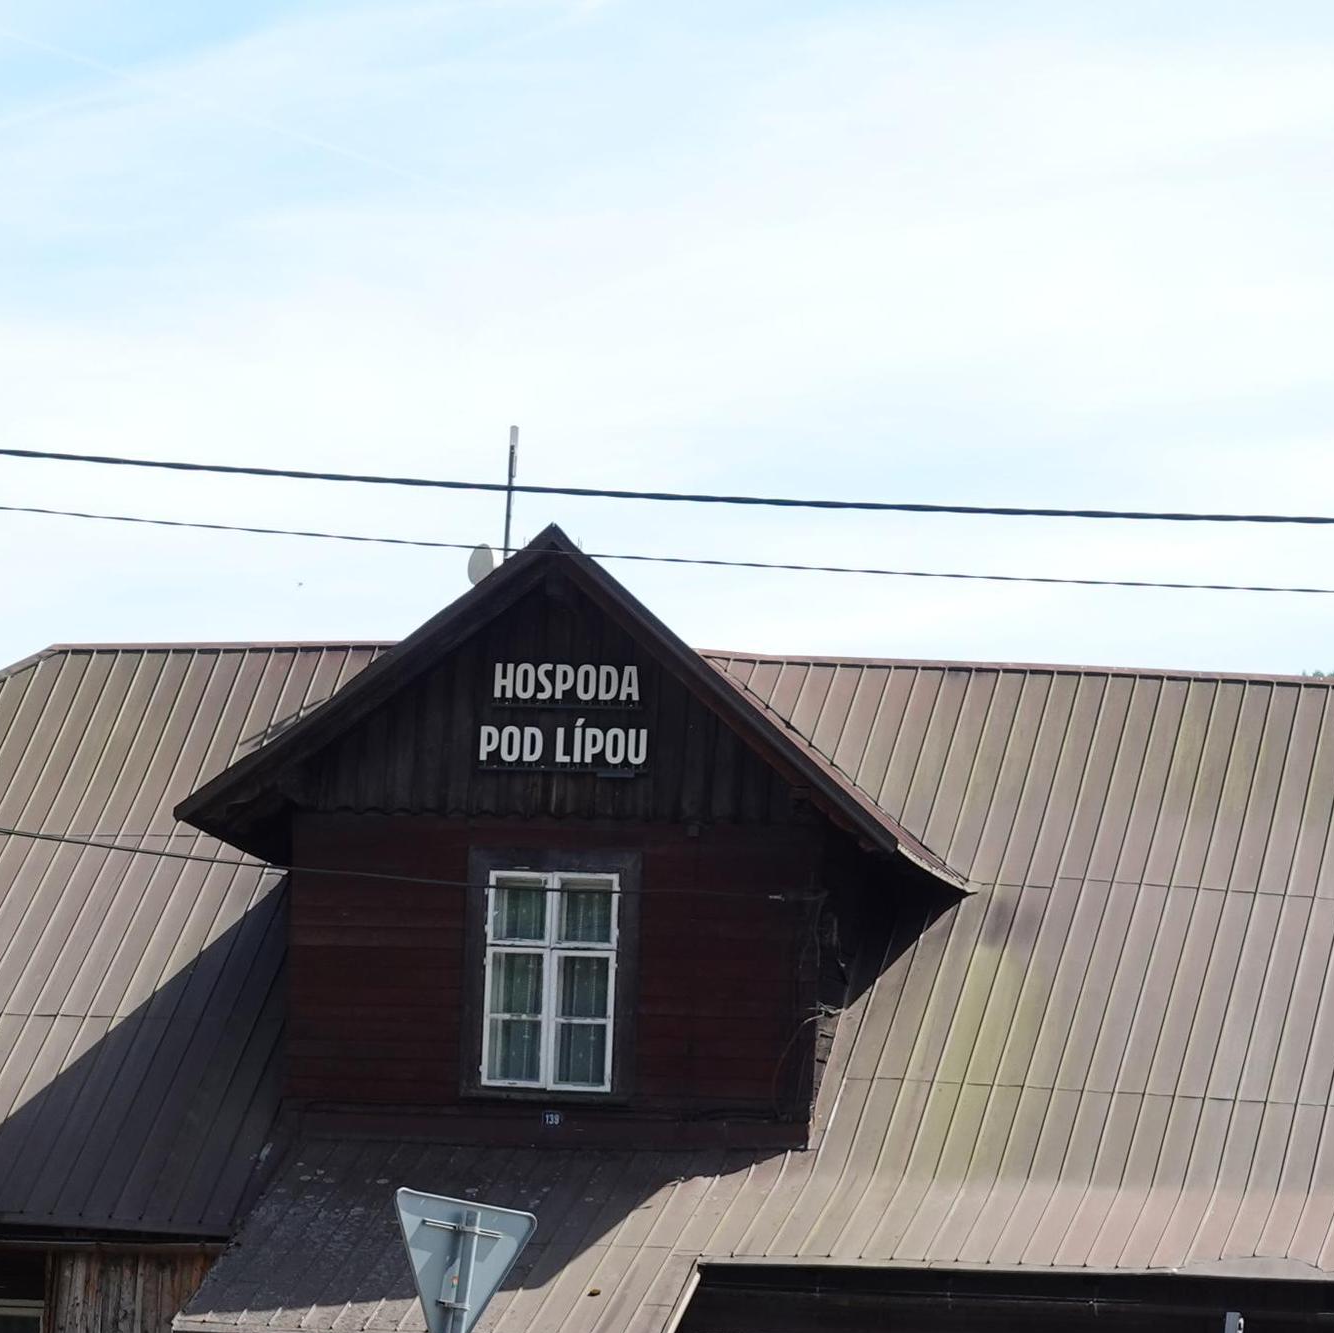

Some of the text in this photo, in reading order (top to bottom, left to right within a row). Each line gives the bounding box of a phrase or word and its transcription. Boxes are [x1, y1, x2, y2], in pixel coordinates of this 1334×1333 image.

[493, 662, 640, 701] HOSPODA
[479, 717, 648, 765] POD LÍPOU
